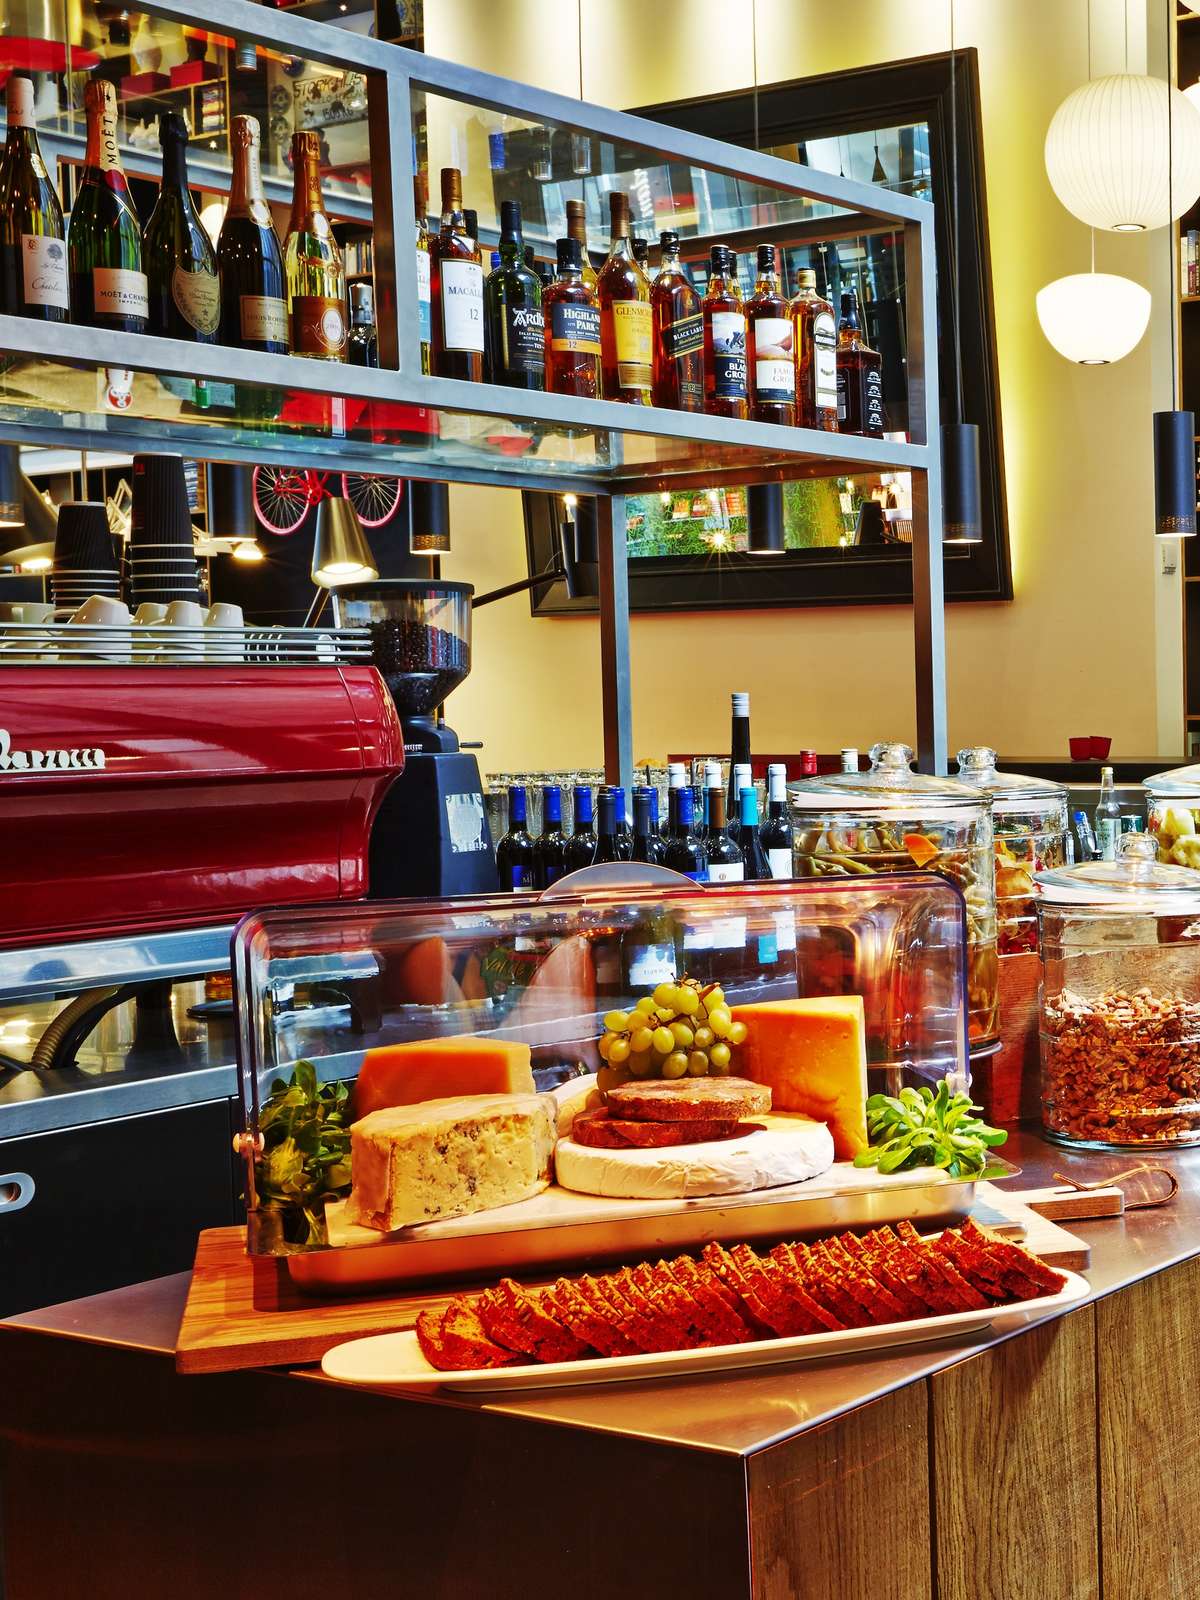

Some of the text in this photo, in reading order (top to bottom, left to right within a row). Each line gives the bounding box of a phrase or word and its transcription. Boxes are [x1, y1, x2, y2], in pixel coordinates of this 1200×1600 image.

[102, 116, 118, 165] MOËT
[100, 290, 122, 298] MOËT
[448, 286, 482, 298] MACALL
[470, 309, 479, 320] 12
[563, 308, 601, 323] HIGHLAN
[576, 320, 596, 332] PARK
[673, 330, 690, 341] BLACK
[728, 363, 746, 371] BLAC
